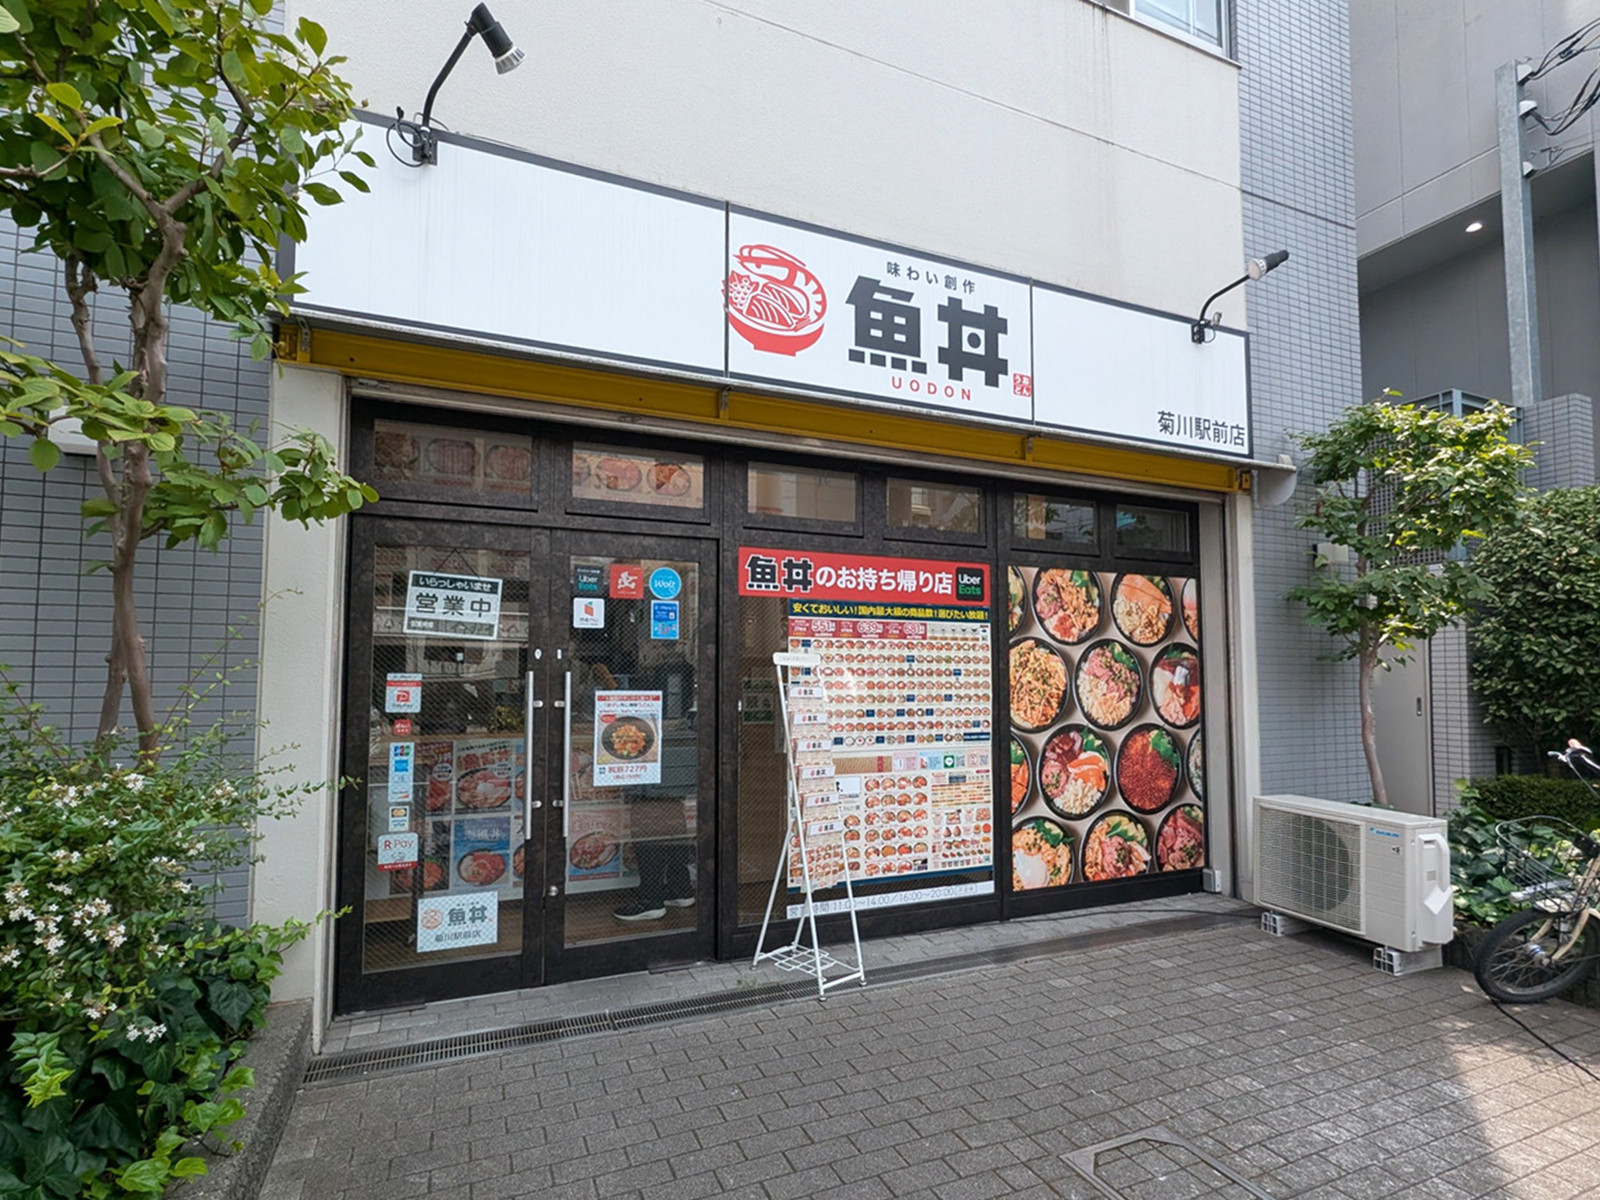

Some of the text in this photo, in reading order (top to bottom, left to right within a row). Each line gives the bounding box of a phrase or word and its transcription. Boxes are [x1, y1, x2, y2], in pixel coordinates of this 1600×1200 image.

[887, 261, 976, 295] 味わい創作
[845, 275, 1009, 388] 魚丼
[891, 376, 972, 401] UODON
[1157, 410, 1246, 447] 菊川駅前店
[419, 576, 492, 592] いらっしゃいませ
[578, 575, 599, 584] Uber
[654, 579, 676, 589] Wolt
[744, 554, 953, 595] 魚丼のお持ち帰り店
[958, 574, 982, 585] Uber
[958, 584, 982, 596] Eats
[416, 591, 491, 618] 営業中
[394, 840, 414, 849] Pay
[447, 905, 488, 927] 魚丼
